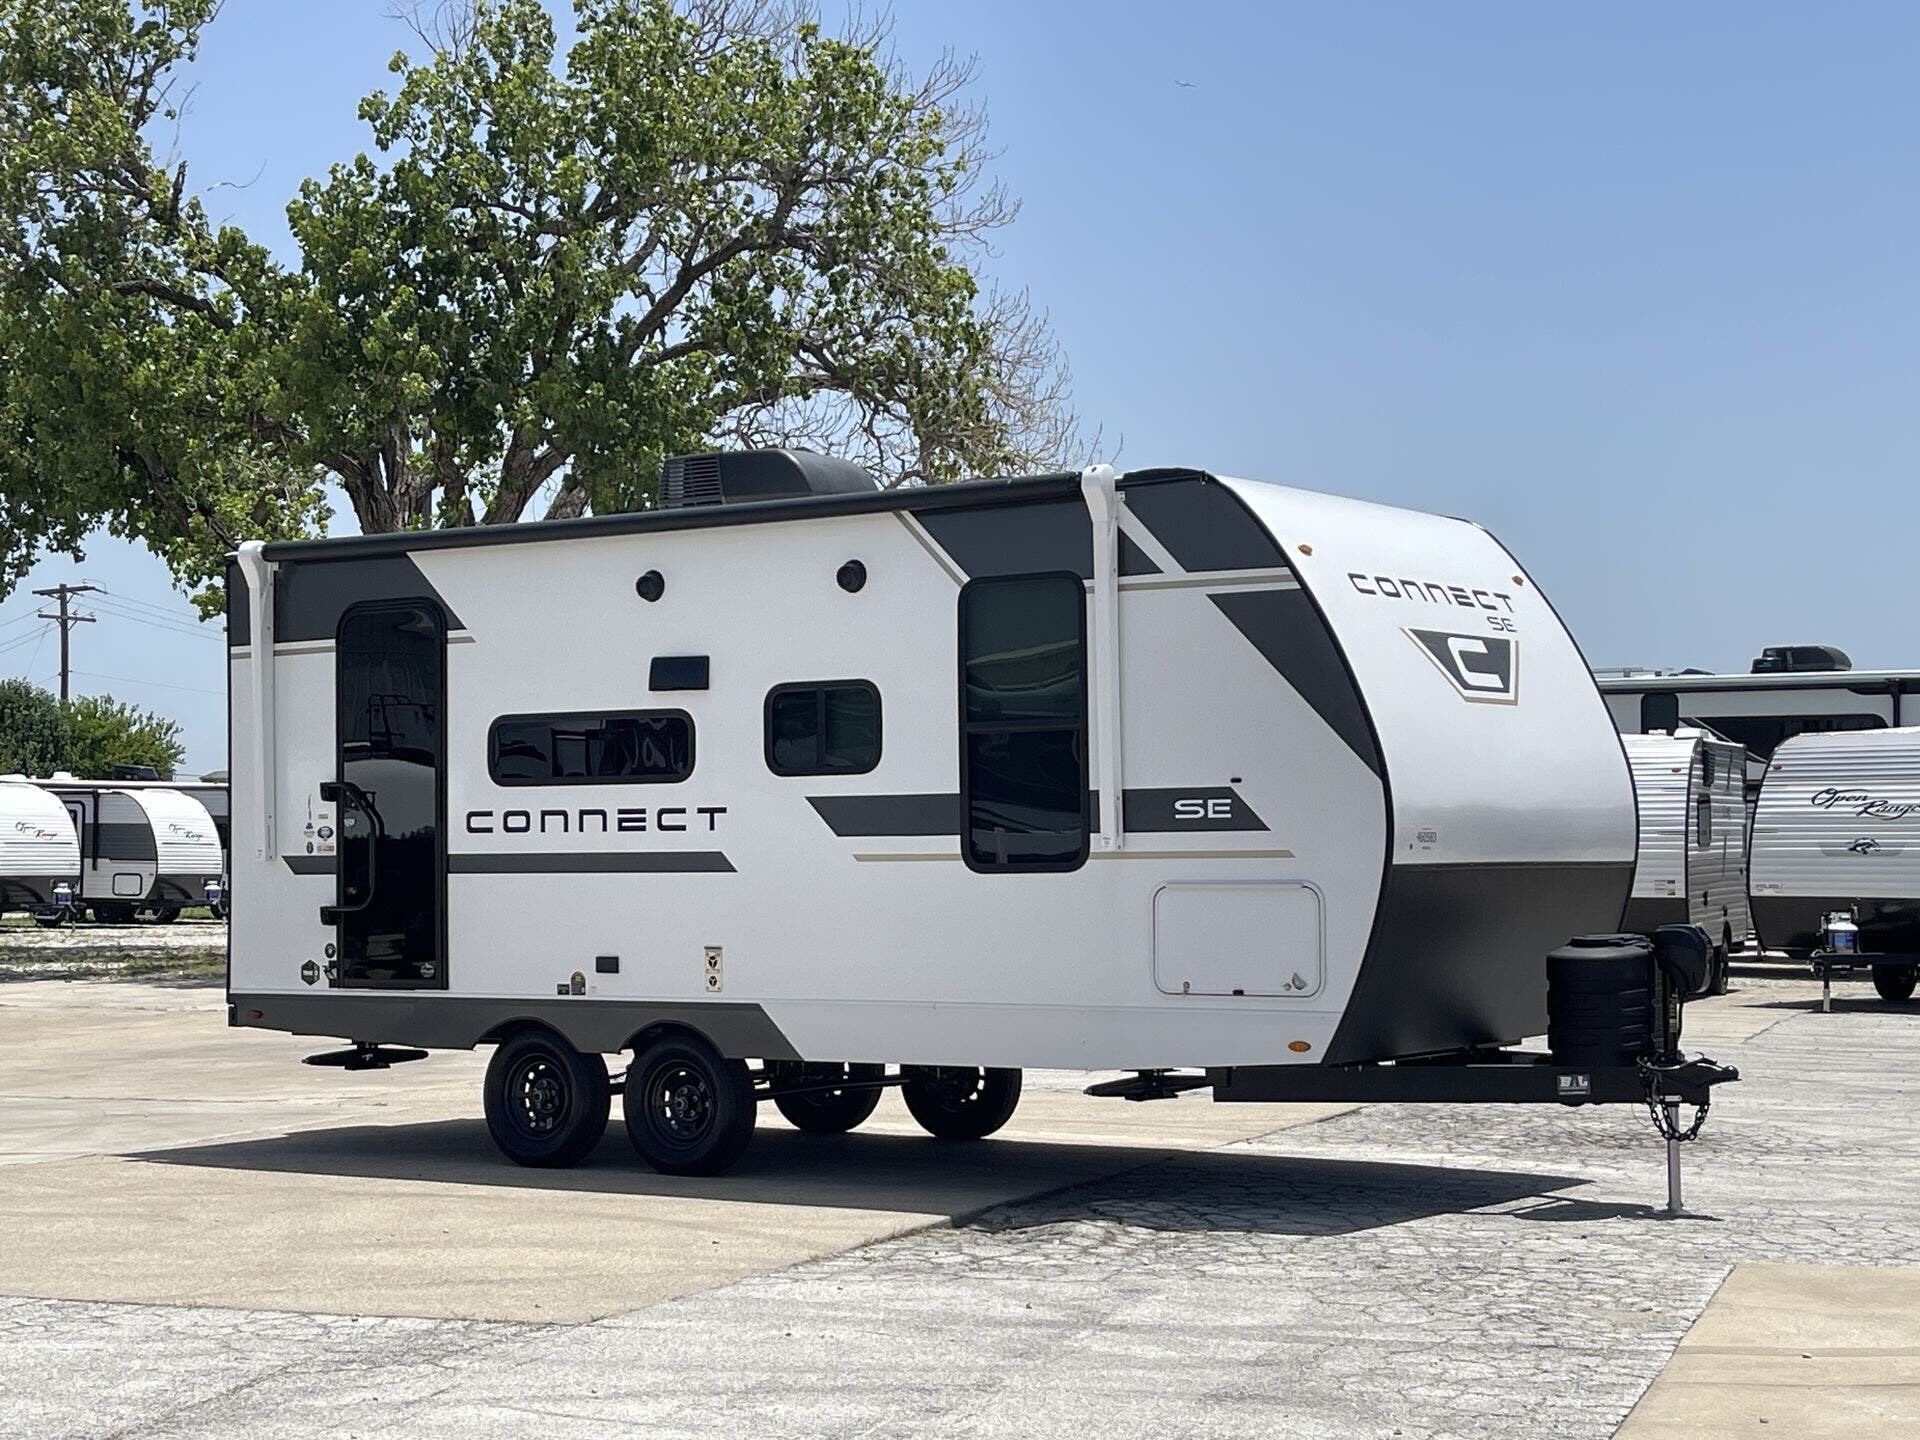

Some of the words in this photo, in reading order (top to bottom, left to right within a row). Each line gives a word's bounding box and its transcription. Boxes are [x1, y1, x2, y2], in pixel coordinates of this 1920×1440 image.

[1347, 572, 1515, 614] CONNECT
[1486, 615, 1518, 633] SE
[1174, 798, 1232, 819] SE
[1811, 787, 1869, 809] Open
[465, 806, 728, 834] CONNECT
